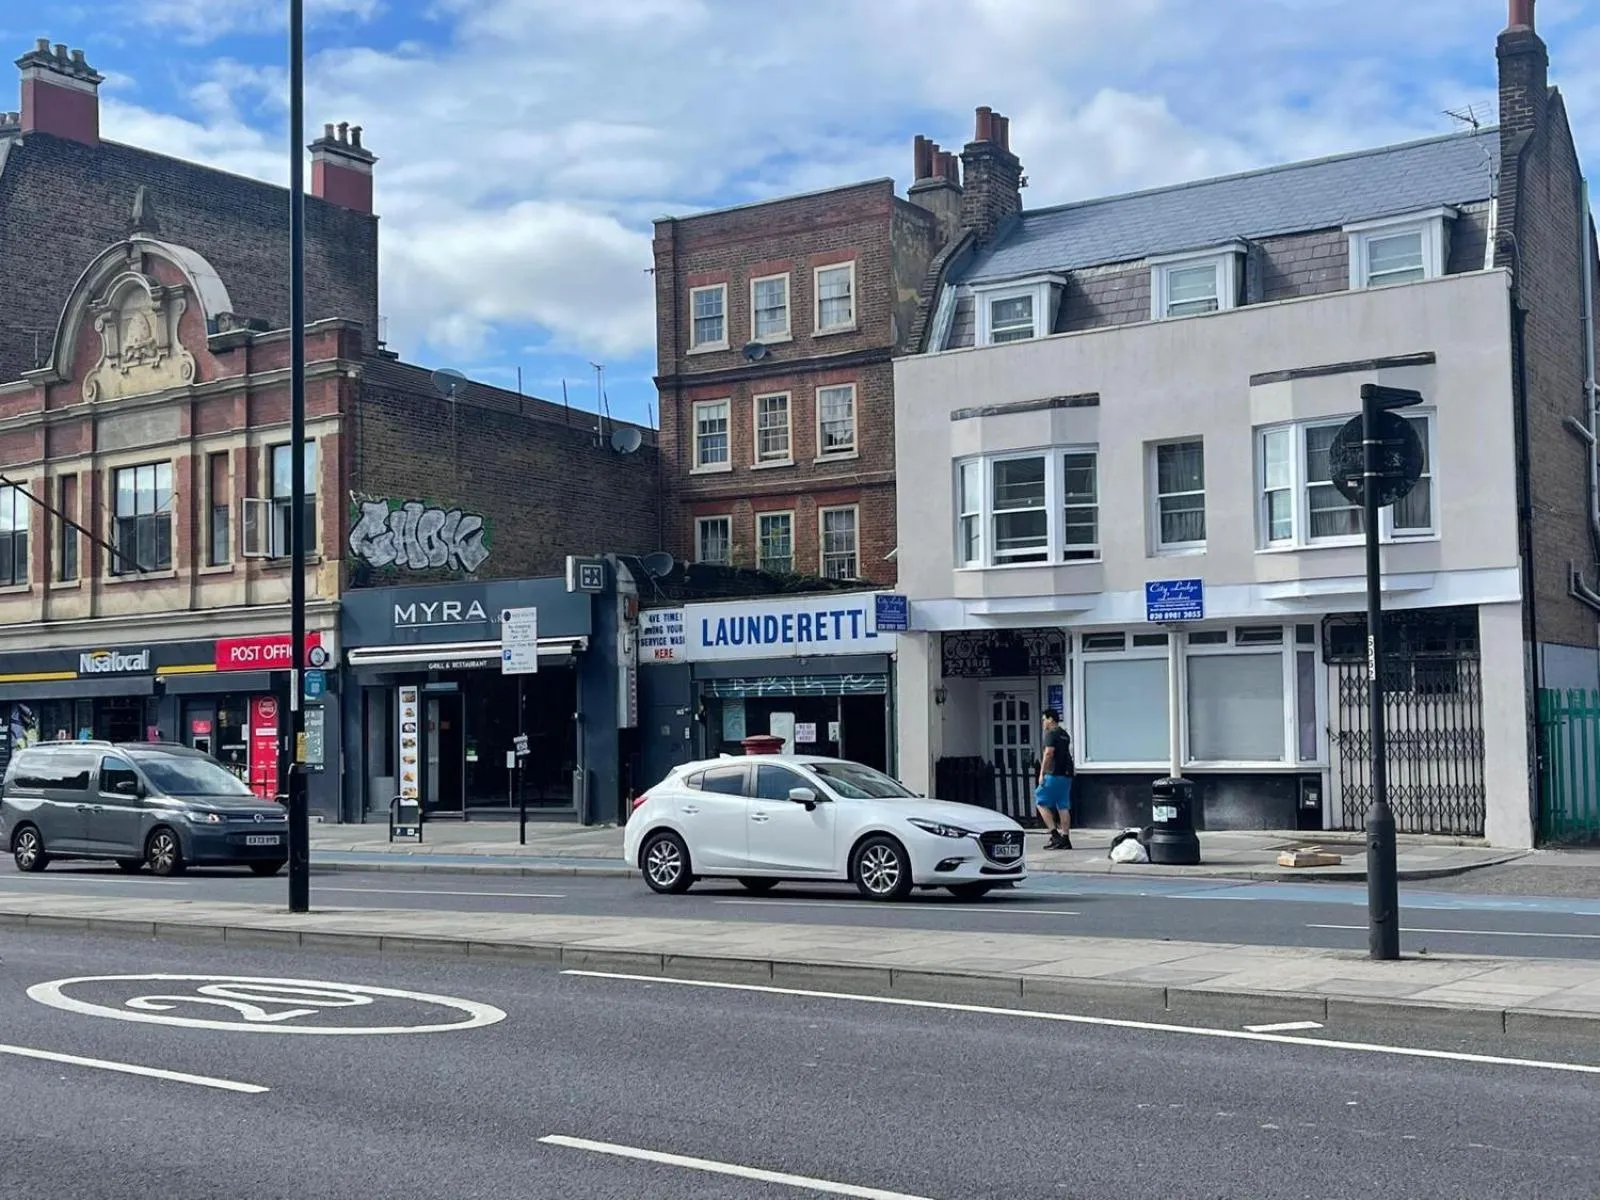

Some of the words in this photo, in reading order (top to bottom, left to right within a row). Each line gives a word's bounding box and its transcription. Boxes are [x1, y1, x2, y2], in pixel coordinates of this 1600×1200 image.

[394, 600, 487, 624] MYRA
[640, 637, 667, 647] SERVICE
[231, 646, 260, 662] POST
[263, 643, 293, 660] OFFI
[654, 648, 673, 659] HERE
